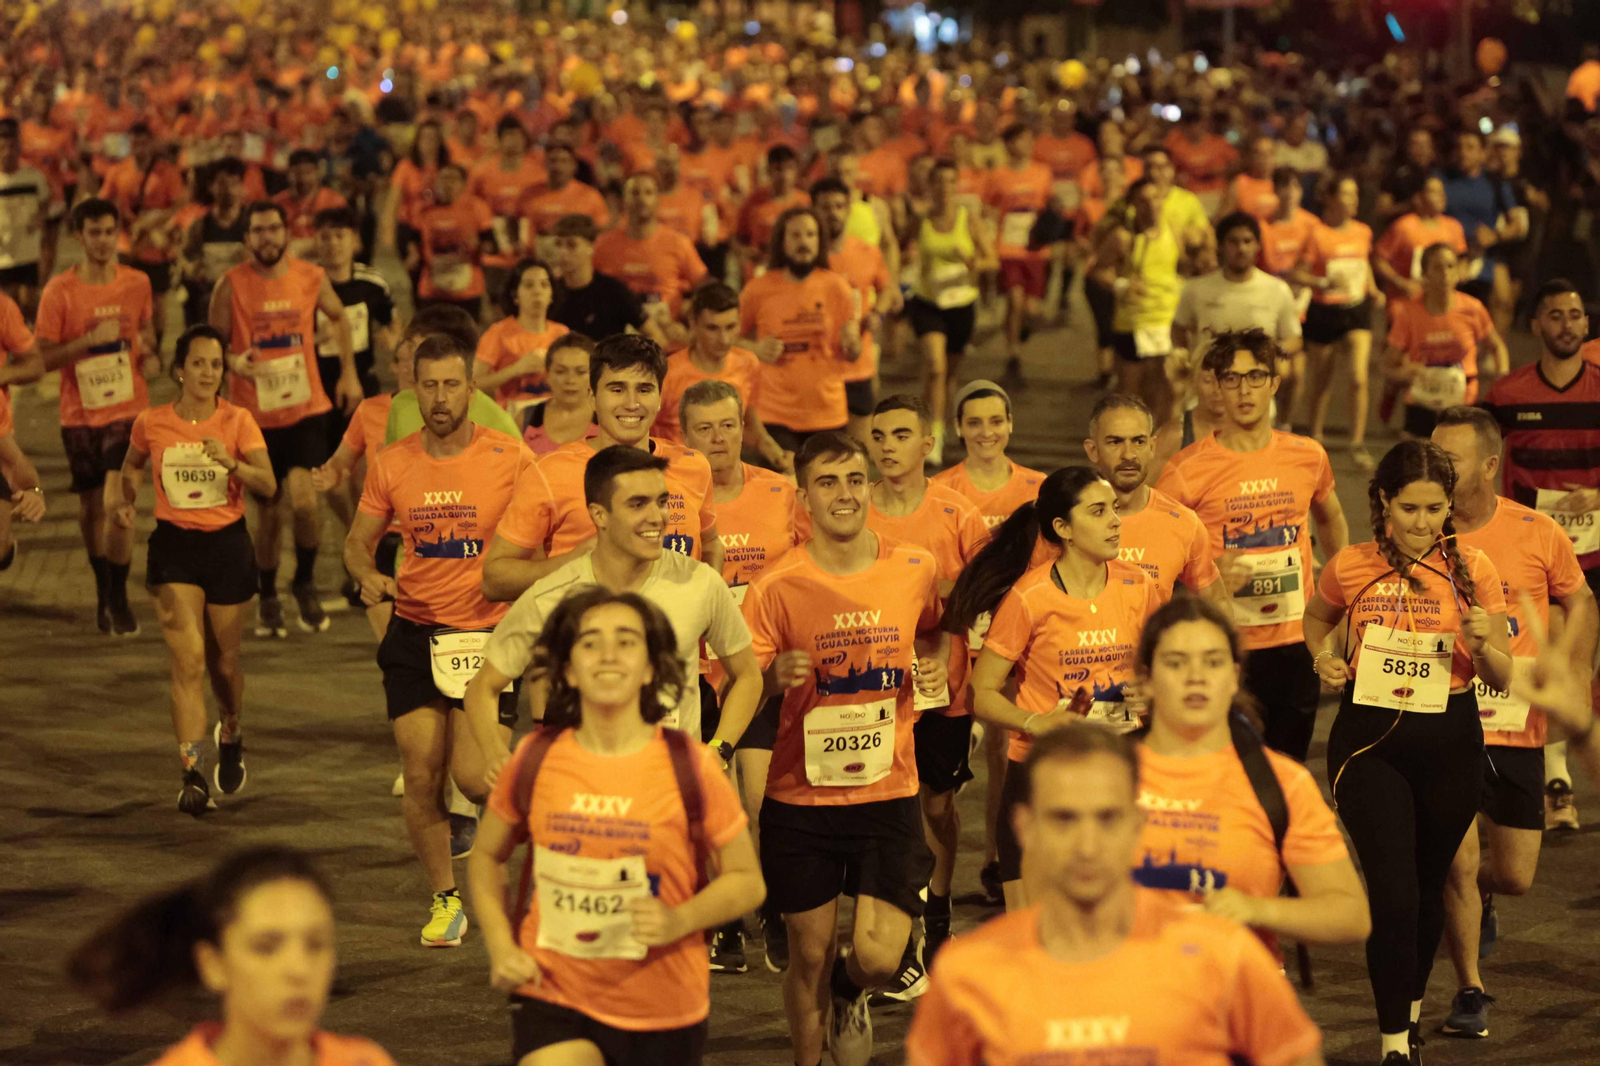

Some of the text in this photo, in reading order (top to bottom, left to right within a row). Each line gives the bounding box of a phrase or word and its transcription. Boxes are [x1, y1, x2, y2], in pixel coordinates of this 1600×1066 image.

[174, 469, 216, 483] 19639
[1239, 477, 1279, 495] XXXV
[423, 491, 463, 505] XXXV
[1231, 497, 1295, 511] GUADALQUIVIR
[408, 505, 439, 513] CARRERA
[414, 511, 477, 521] GUADALQUIVIR
[726, 547, 765, 555] NOCTURNA
[1253, 577, 1282, 595] 891
[1357, 596, 1392, 605] CARRERA
[832, 609, 882, 630] XXXV
[814, 626, 899, 642] CARRERA NOCTURNA
[1077, 628, 1117, 647] XXXV
[821, 634, 900, 651] GUADALQUIVIR
[1058, 643, 1133, 657] CARRERA NOCTURNA
[451, 655, 485, 671] 912
[1382, 657, 1430, 678] 5838
[823, 731, 882, 753] 20326
[570, 792, 632, 817] XXXV
[552, 889, 624, 916] 21462
